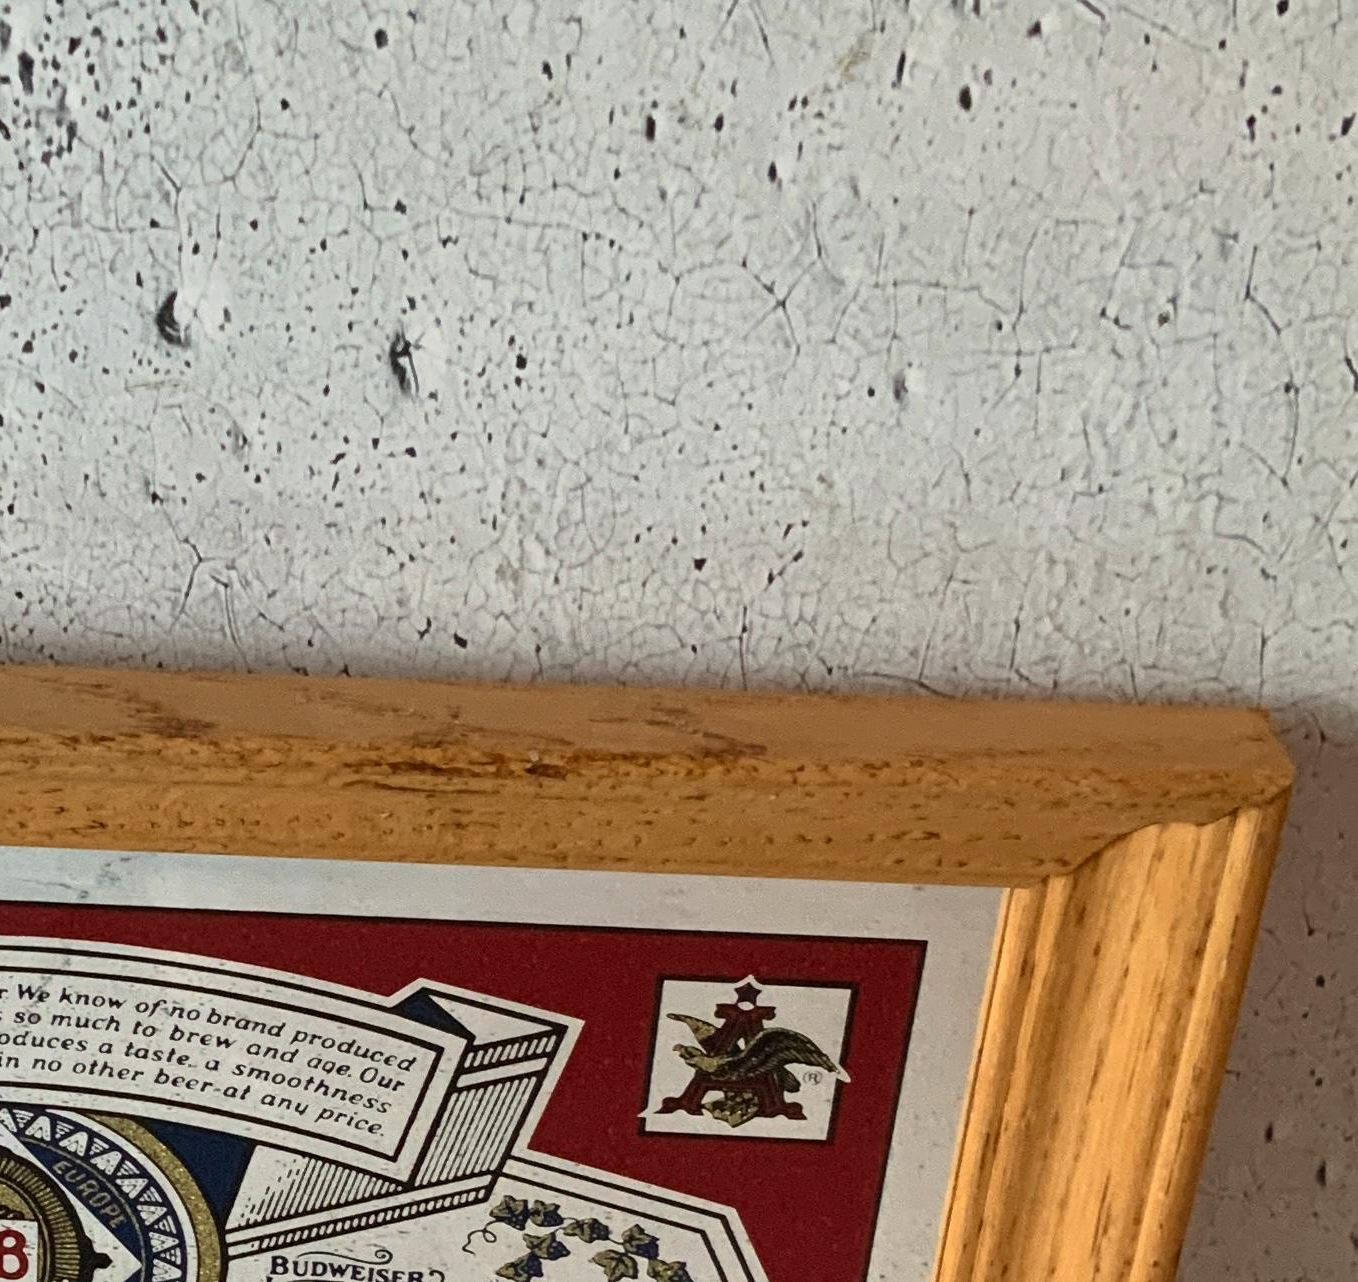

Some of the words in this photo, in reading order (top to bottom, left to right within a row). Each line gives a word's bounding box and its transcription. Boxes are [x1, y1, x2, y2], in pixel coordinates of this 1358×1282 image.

[13, 1011, 41, 1025] so
[50, 1014, 121, 1032] much
[132, 1020, 157, 1037] to
[169, 1024, 238, 1050] brew
[246, 1042, 299, 1064] and
[359, 1066, 405, 1093] Our
[18, 984, 50, 1003] We
[59, 987, 126, 1009] know
[207, 1008, 286, 1037] brand
[290, 1030, 417, 1073] produced
[31, 1056, 62, 1072] no
[72, 1059, 144, 1081] other
[260, 1094, 310, 1115] any
[314, 1107, 384, 1137] price.
[98, 1042, 113, 1055] a
[205, 1059, 220, 1071] a
[232, 1062, 392, 1114] smoothness
[51, 1159, 128, 1229] EUROPE
